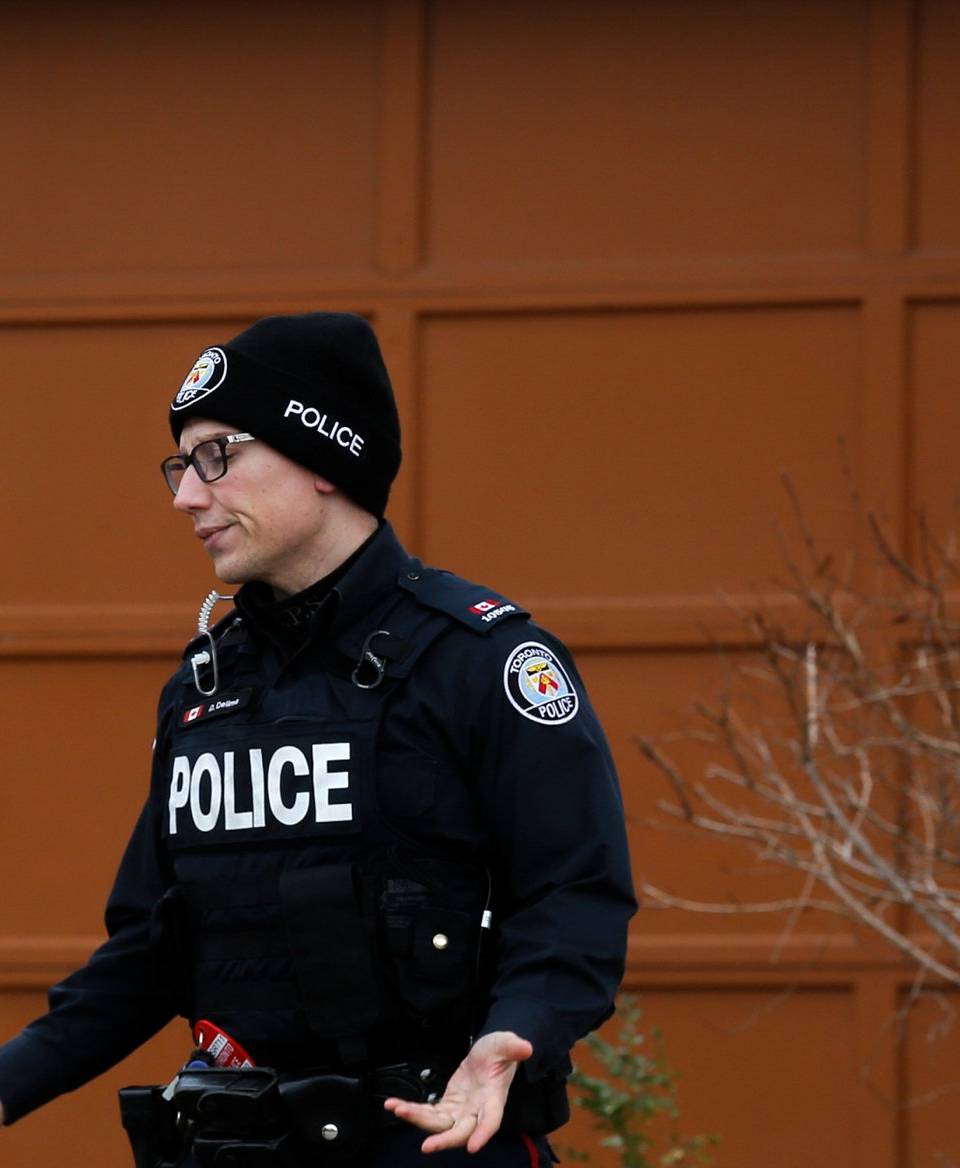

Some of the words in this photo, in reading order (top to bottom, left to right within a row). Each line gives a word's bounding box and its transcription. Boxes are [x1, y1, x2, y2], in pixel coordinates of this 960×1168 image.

[283, 399, 365, 457] POLICE
[510, 648, 553, 674] TORONTO
[538, 697, 574, 718] POLICE
[168, 742, 353, 835] POLICE
